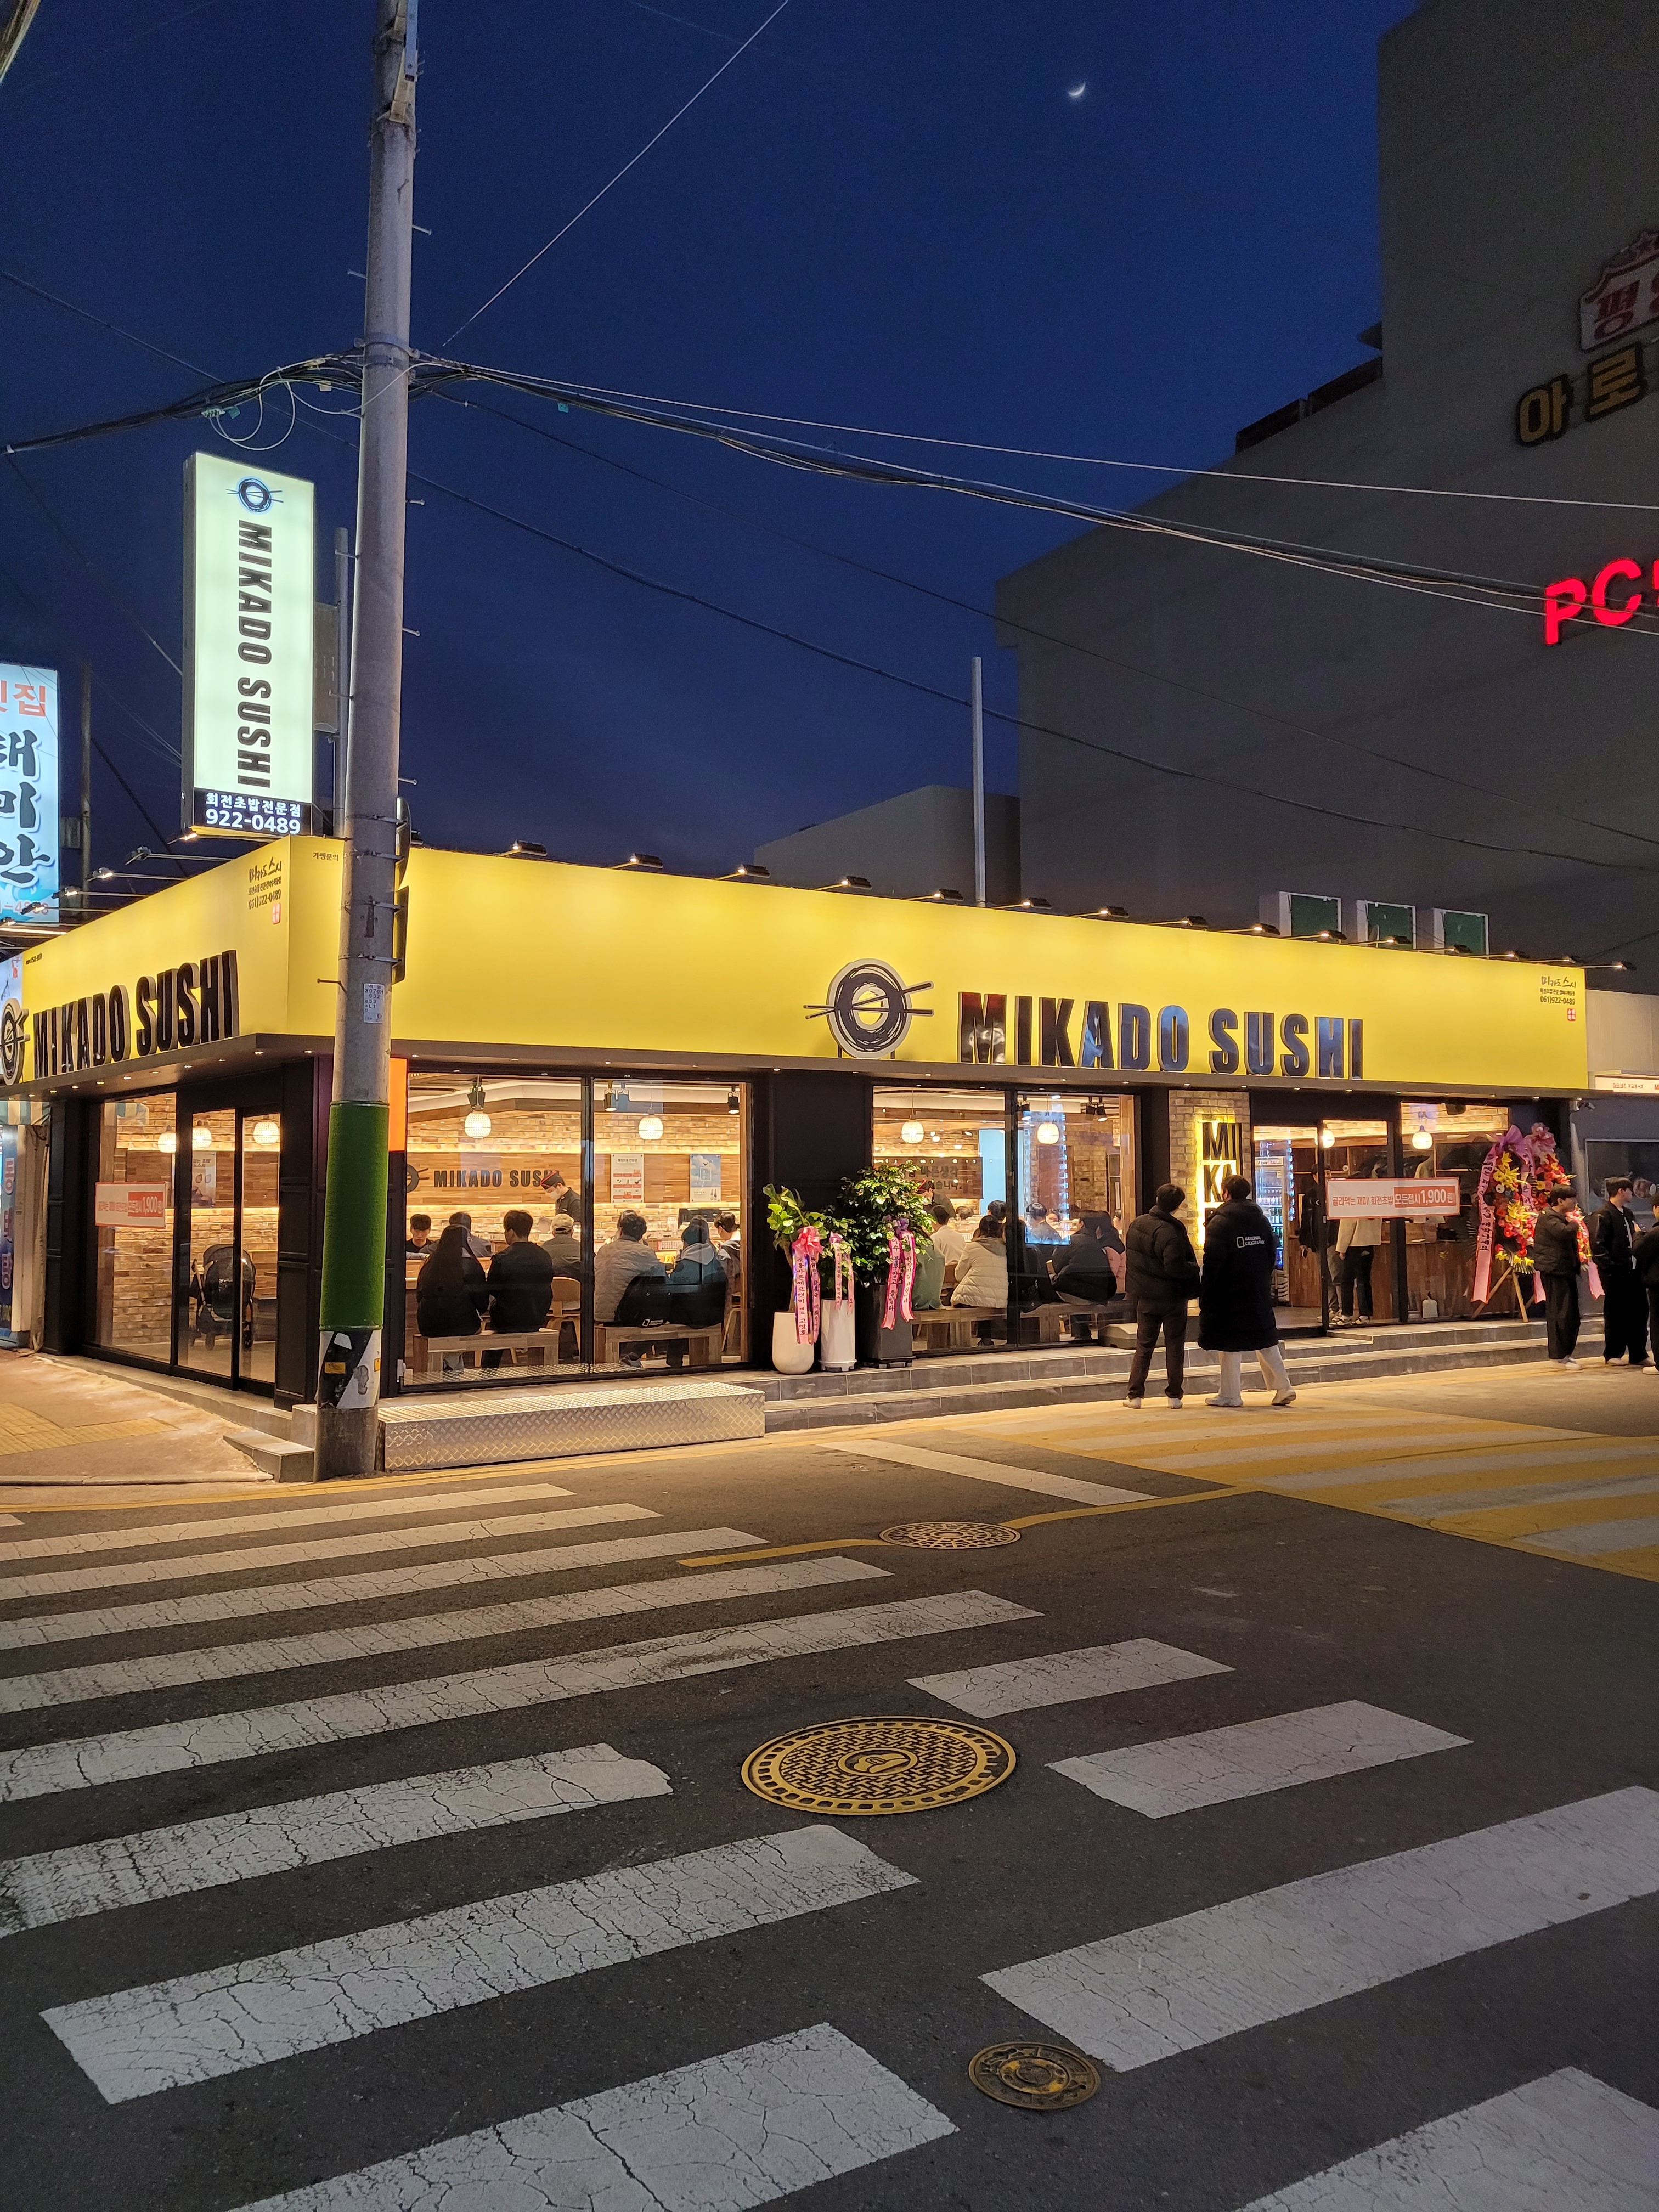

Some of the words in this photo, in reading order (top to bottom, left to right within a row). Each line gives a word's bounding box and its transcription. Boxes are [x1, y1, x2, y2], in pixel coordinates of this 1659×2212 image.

[238, 520, 272, 665] MIKADO
[1545, 558, 1659, 645] PC
[237, 677, 271, 788] SUSHI
[206, 809, 301, 834] 922-0489
[313, 852, 339, 861] 가맹문의
[1540, 996, 1576, 1005] 061)922-0489
[33, 985, 131, 1080] MIKADO
[136, 950, 240, 1057] SUSHI
[958, 991, 1189, 1073] MIKADO
[1209, 1008, 1363, 1080] SUSHI
[434, 1170, 502, 1187] MIKADO
[510, 1170, 561, 1187] SUS
[143, 1196, 157, 1215] 1,900
[1371, 1195, 1393, 1205] 회전초밥
[1395, 1193, 1420, 1205] 모든접시
[1421, 1189, 1447, 1205] 1,900
